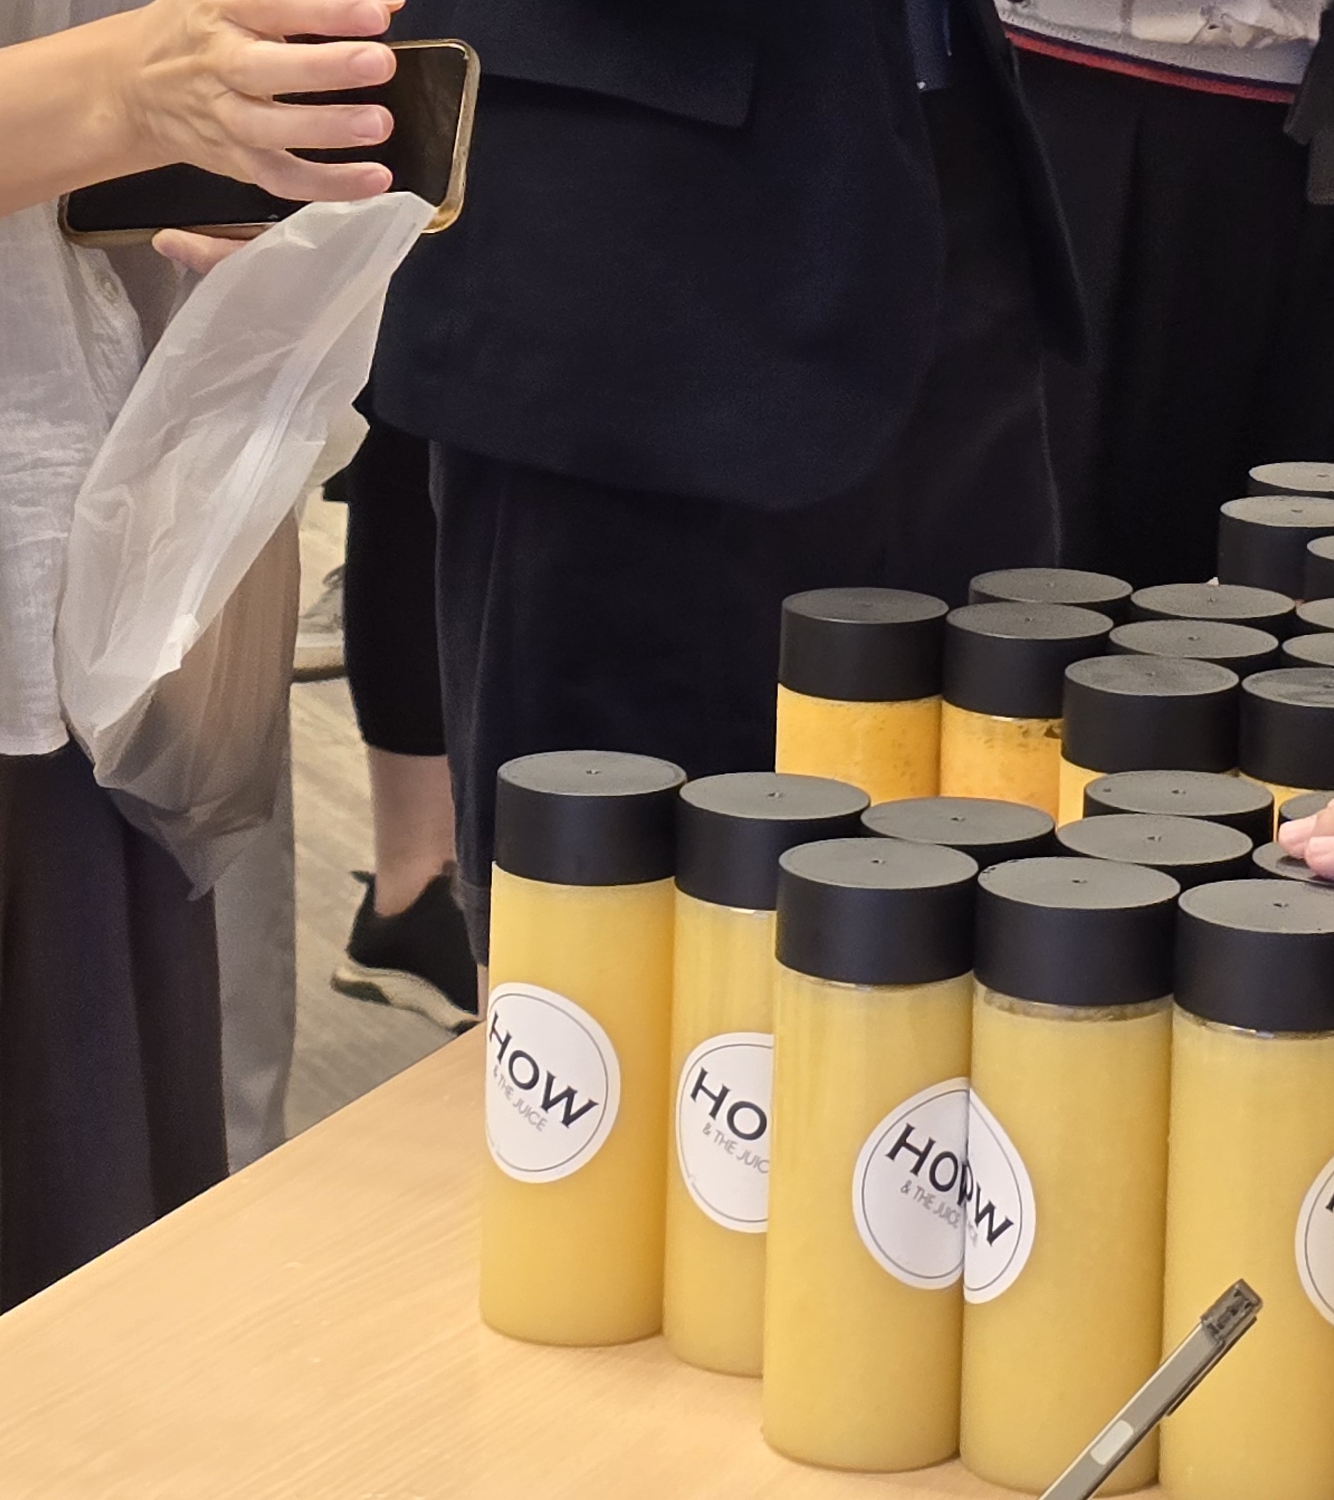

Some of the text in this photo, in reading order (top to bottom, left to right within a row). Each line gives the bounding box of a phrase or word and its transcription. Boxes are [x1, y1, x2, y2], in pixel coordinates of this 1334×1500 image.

[489, 1011, 599, 1129] HOW
[512, 1098, 547, 1132] JUICE
[690, 1066, 768, 1141] HO
[702, 1122, 771, 1174] & THE JUIC
[900, 1180, 912, 1196] &
[913, 1186, 936, 1211] THE
